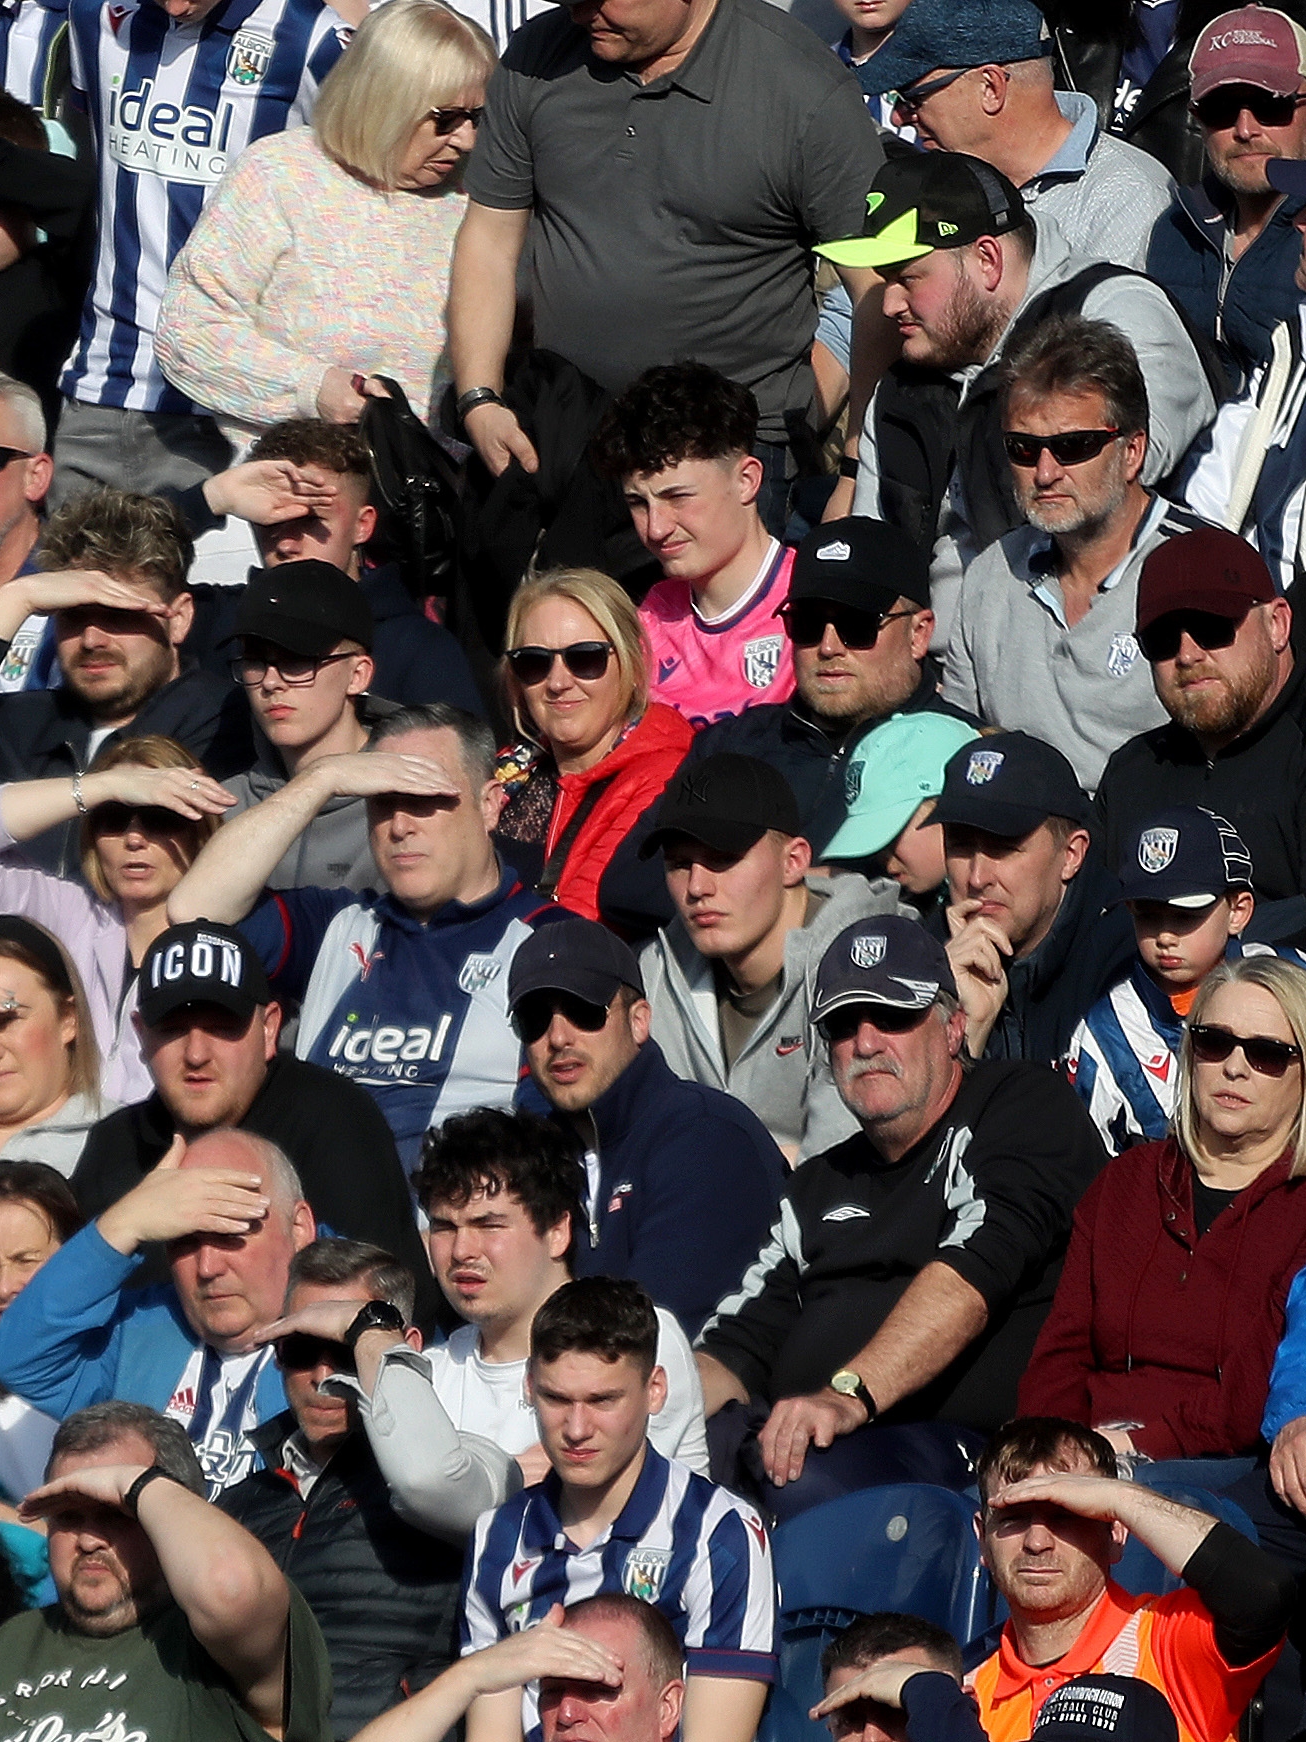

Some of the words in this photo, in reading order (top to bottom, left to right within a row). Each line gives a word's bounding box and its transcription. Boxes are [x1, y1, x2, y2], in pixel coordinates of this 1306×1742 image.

[234, 36, 272, 55] ALBION
[109, 76, 234, 152] ideal
[109, 133, 227, 175] HEATING
[152, 943, 241, 990] ICON
[328, 1013, 452, 1063] ideal
[630, 1553, 670, 1565] ALBION
[1045, 1702, 1086, 1715] OOTBALL
[1092, 1704, 1119, 1721] CLUB
